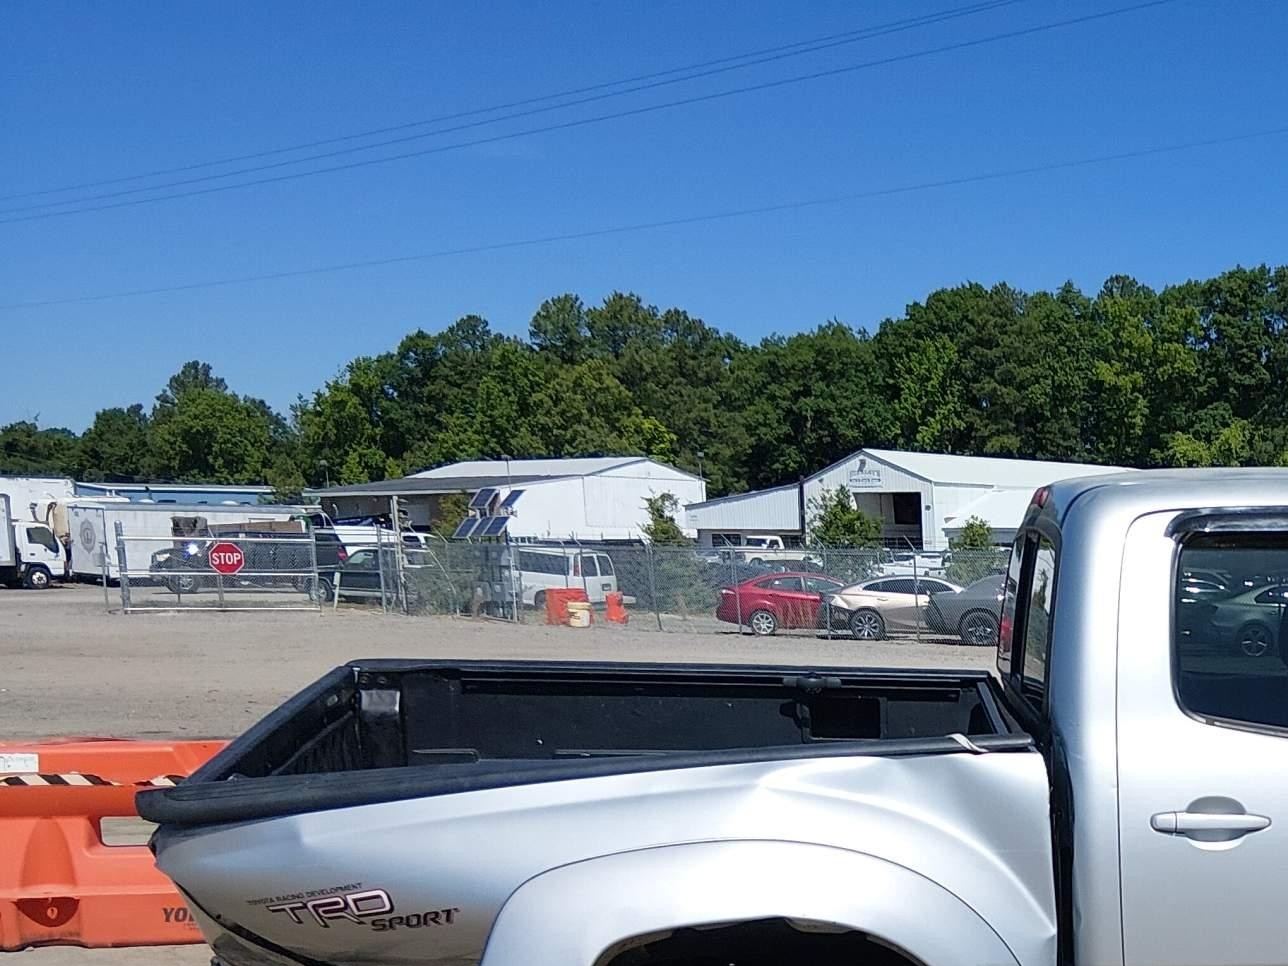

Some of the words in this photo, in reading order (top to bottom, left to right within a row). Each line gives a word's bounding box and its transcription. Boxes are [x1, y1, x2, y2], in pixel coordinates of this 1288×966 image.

[212, 552, 241, 565] STOP
[266, 888, 394, 929] TRD
[371, 908, 460, 932] SPORT
